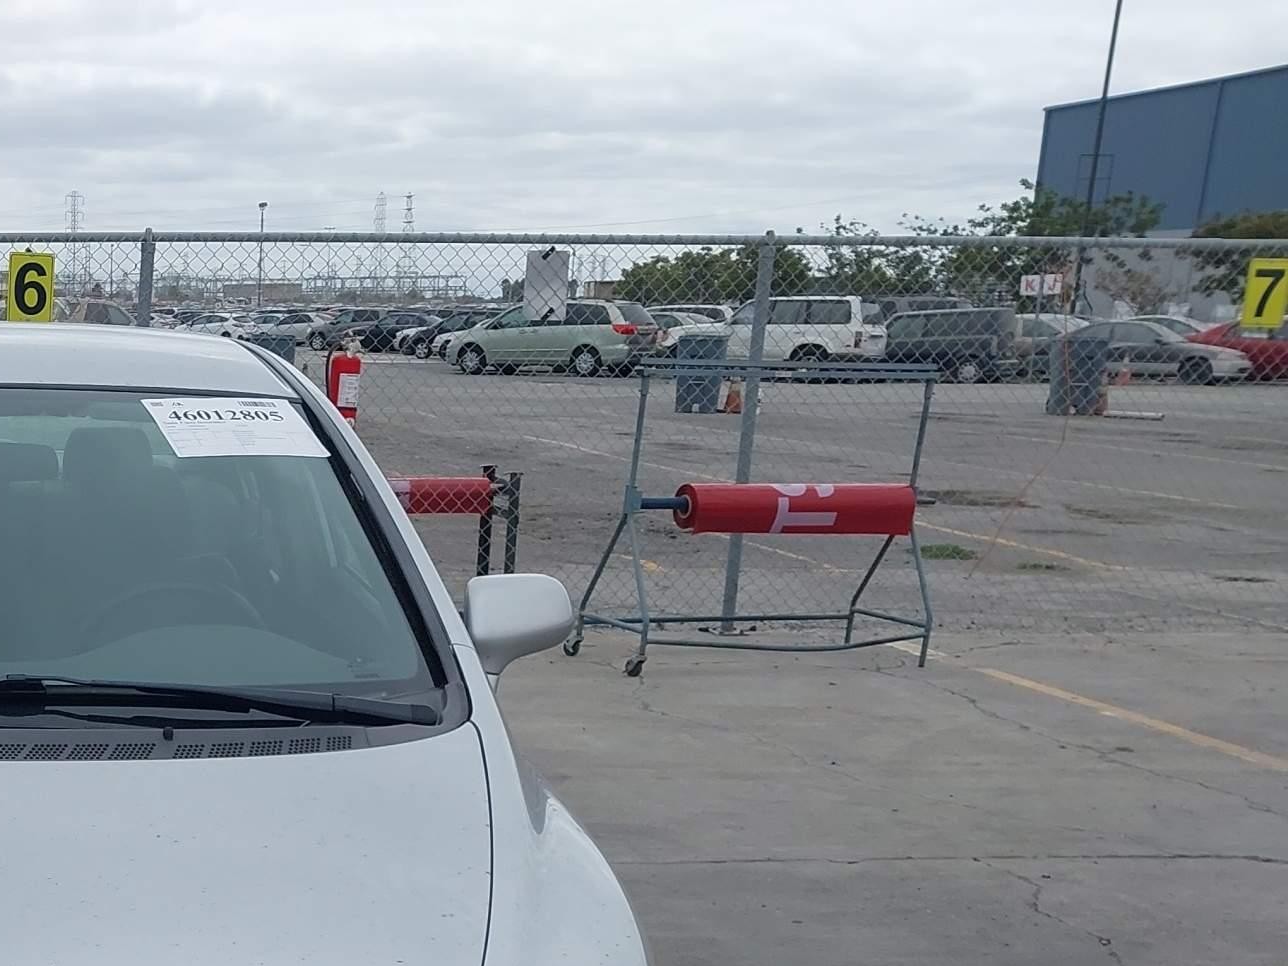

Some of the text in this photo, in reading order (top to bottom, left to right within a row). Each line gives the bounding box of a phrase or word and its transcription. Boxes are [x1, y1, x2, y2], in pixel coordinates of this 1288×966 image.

[14, 262, 47, 316] 6
[1025, 278, 1036, 291] K
[1254, 269, 1286, 317] 7
[168, 409, 284, 422] 46012805
